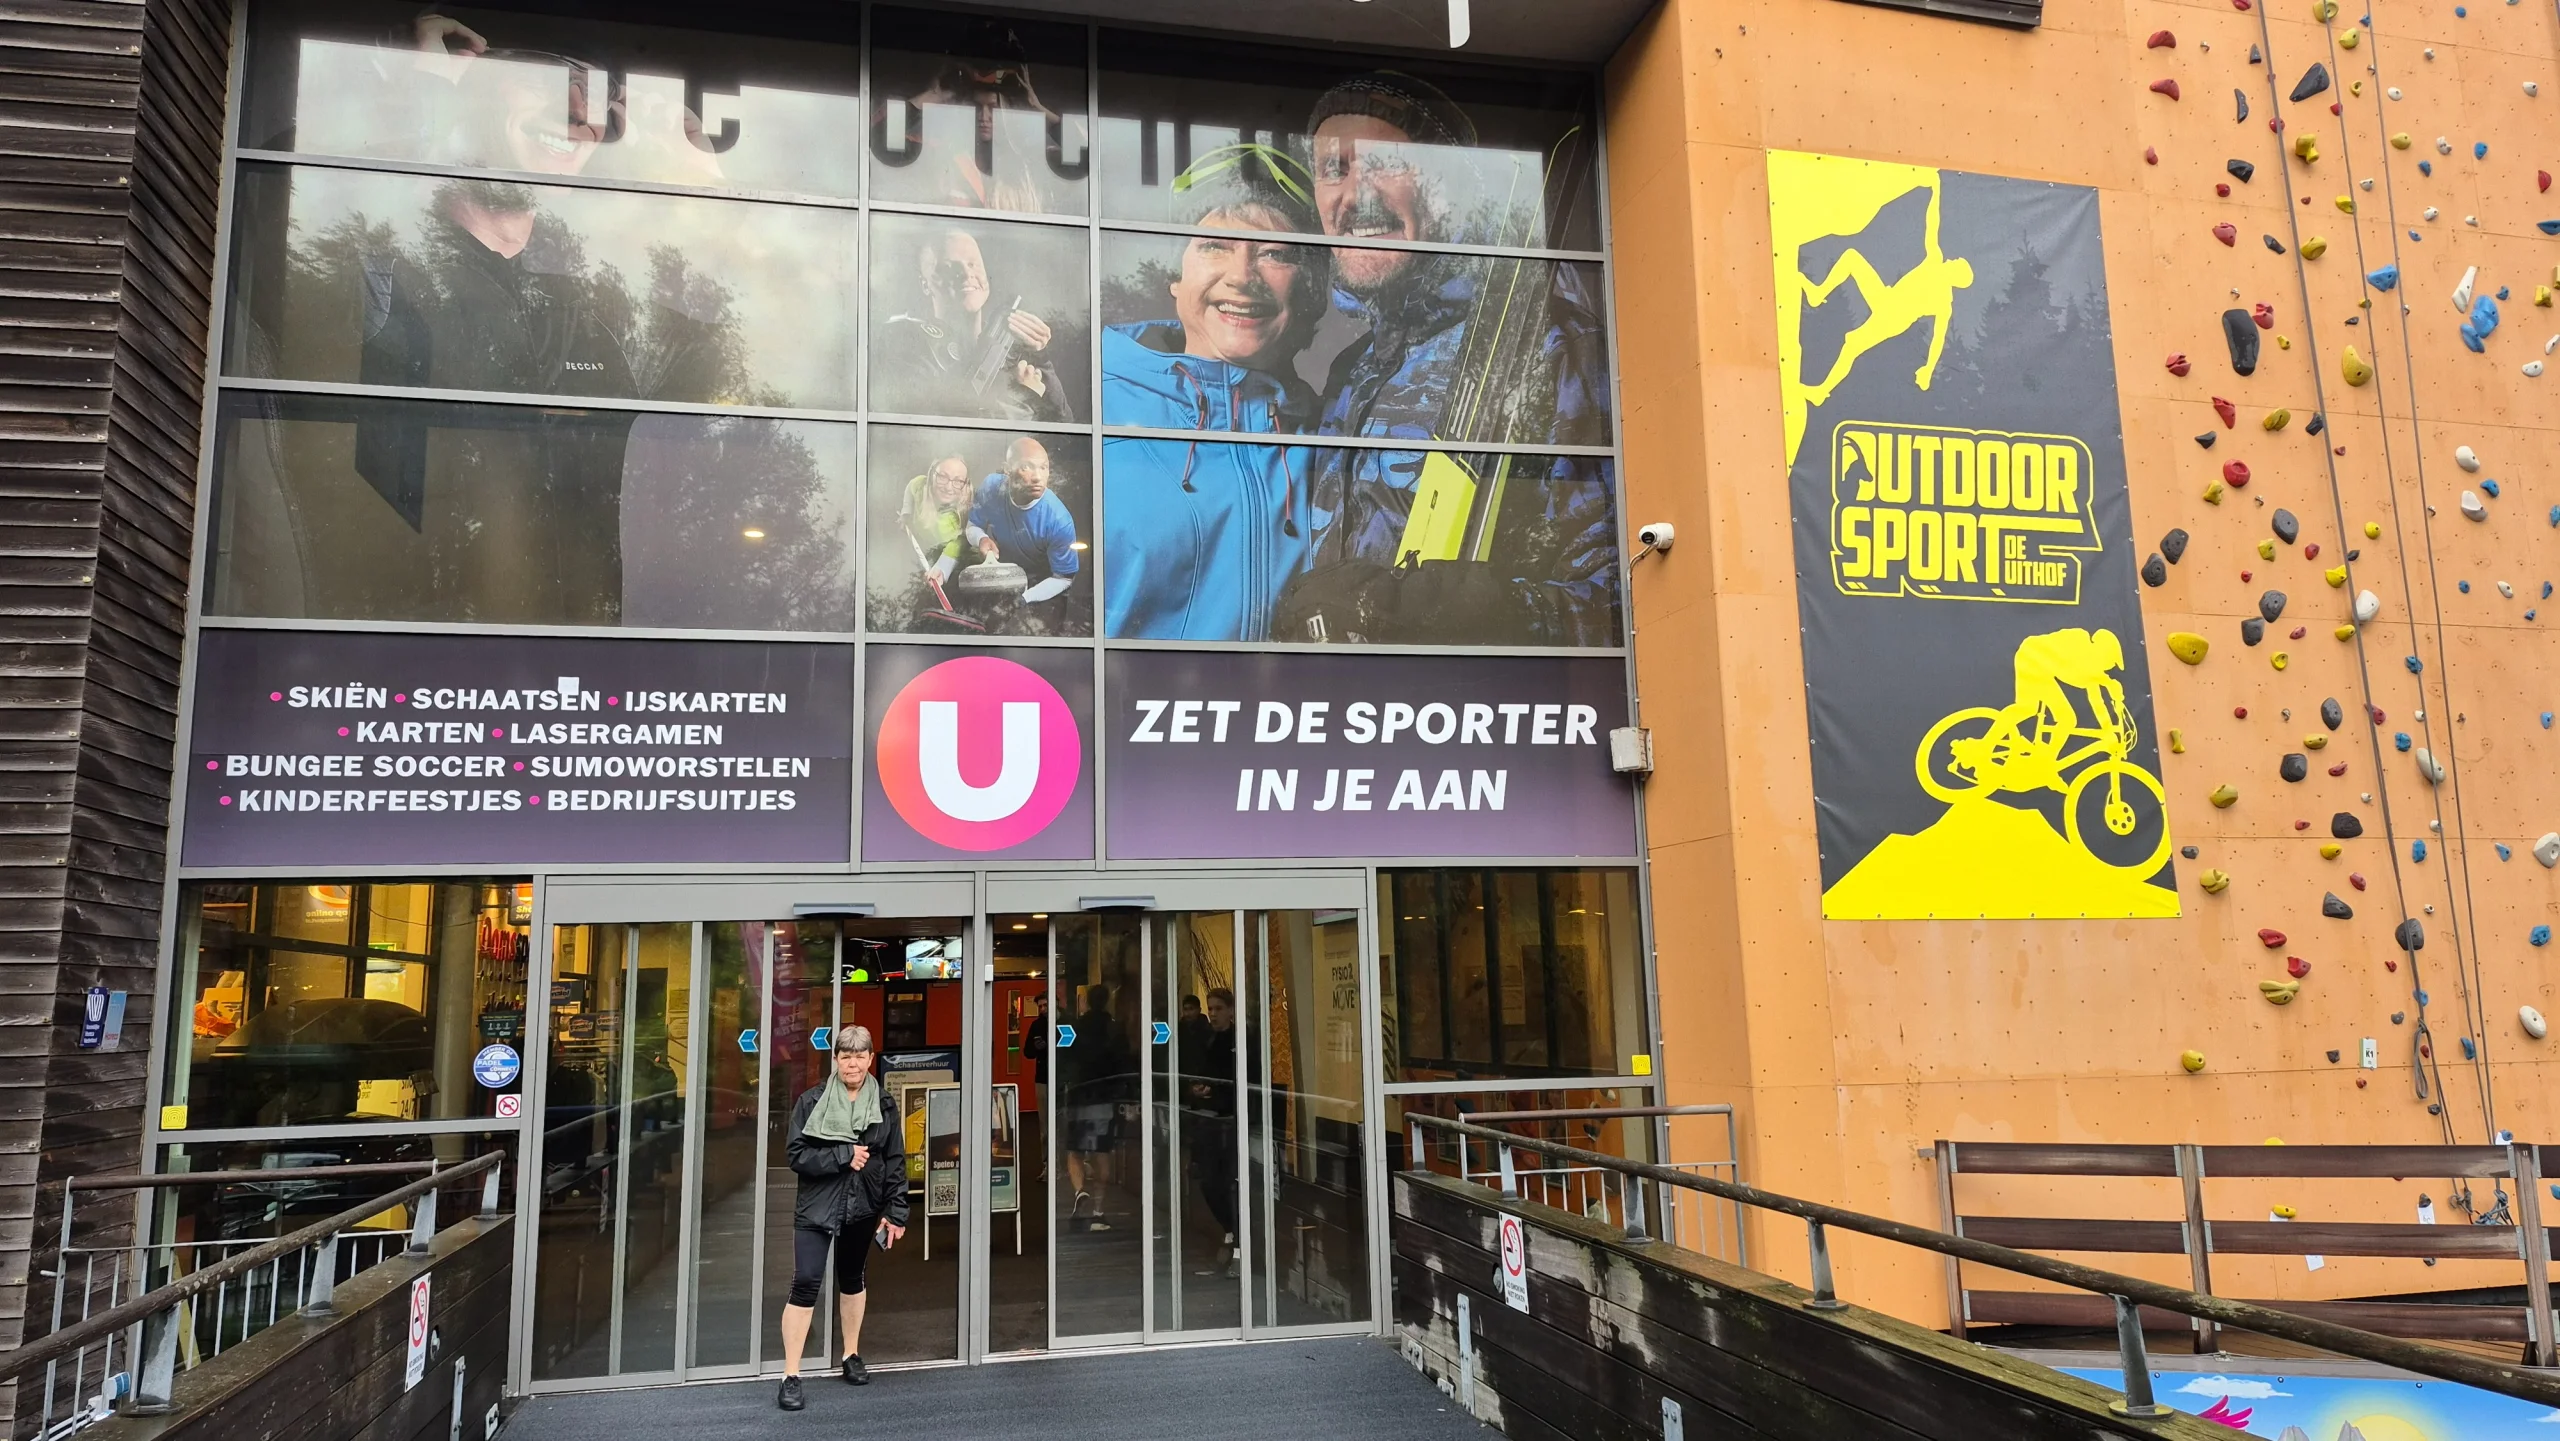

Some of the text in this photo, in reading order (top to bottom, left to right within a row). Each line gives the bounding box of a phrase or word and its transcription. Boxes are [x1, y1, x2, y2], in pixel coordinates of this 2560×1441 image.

[1841, 431, 2079, 513] OUTDOOR
[1841, 506, 2084, 584] SPORT
[2004, 535, 2027, 559] DE
[2004, 560, 2067, 586] UITHOF
[288, 682, 787, 713] SKIËN SCHAATSEN IJSKARTEN
[356, 722, 723, 745] KARTEN LASERGAMEN
[1129, 700, 1598, 745] ZET DE SPORTER
[226, 756, 811, 778] BUNGEE SOCCER SUMOWORSTELEN
[919, 701, 1041, 822] U
[239, 790, 797, 812] KINDERFEESTJES BEDRIJFSUITJES
[1236, 769, 1508, 811] IN JE AAN
[893, 1060, 950, 1069] Schaatsverhuur
